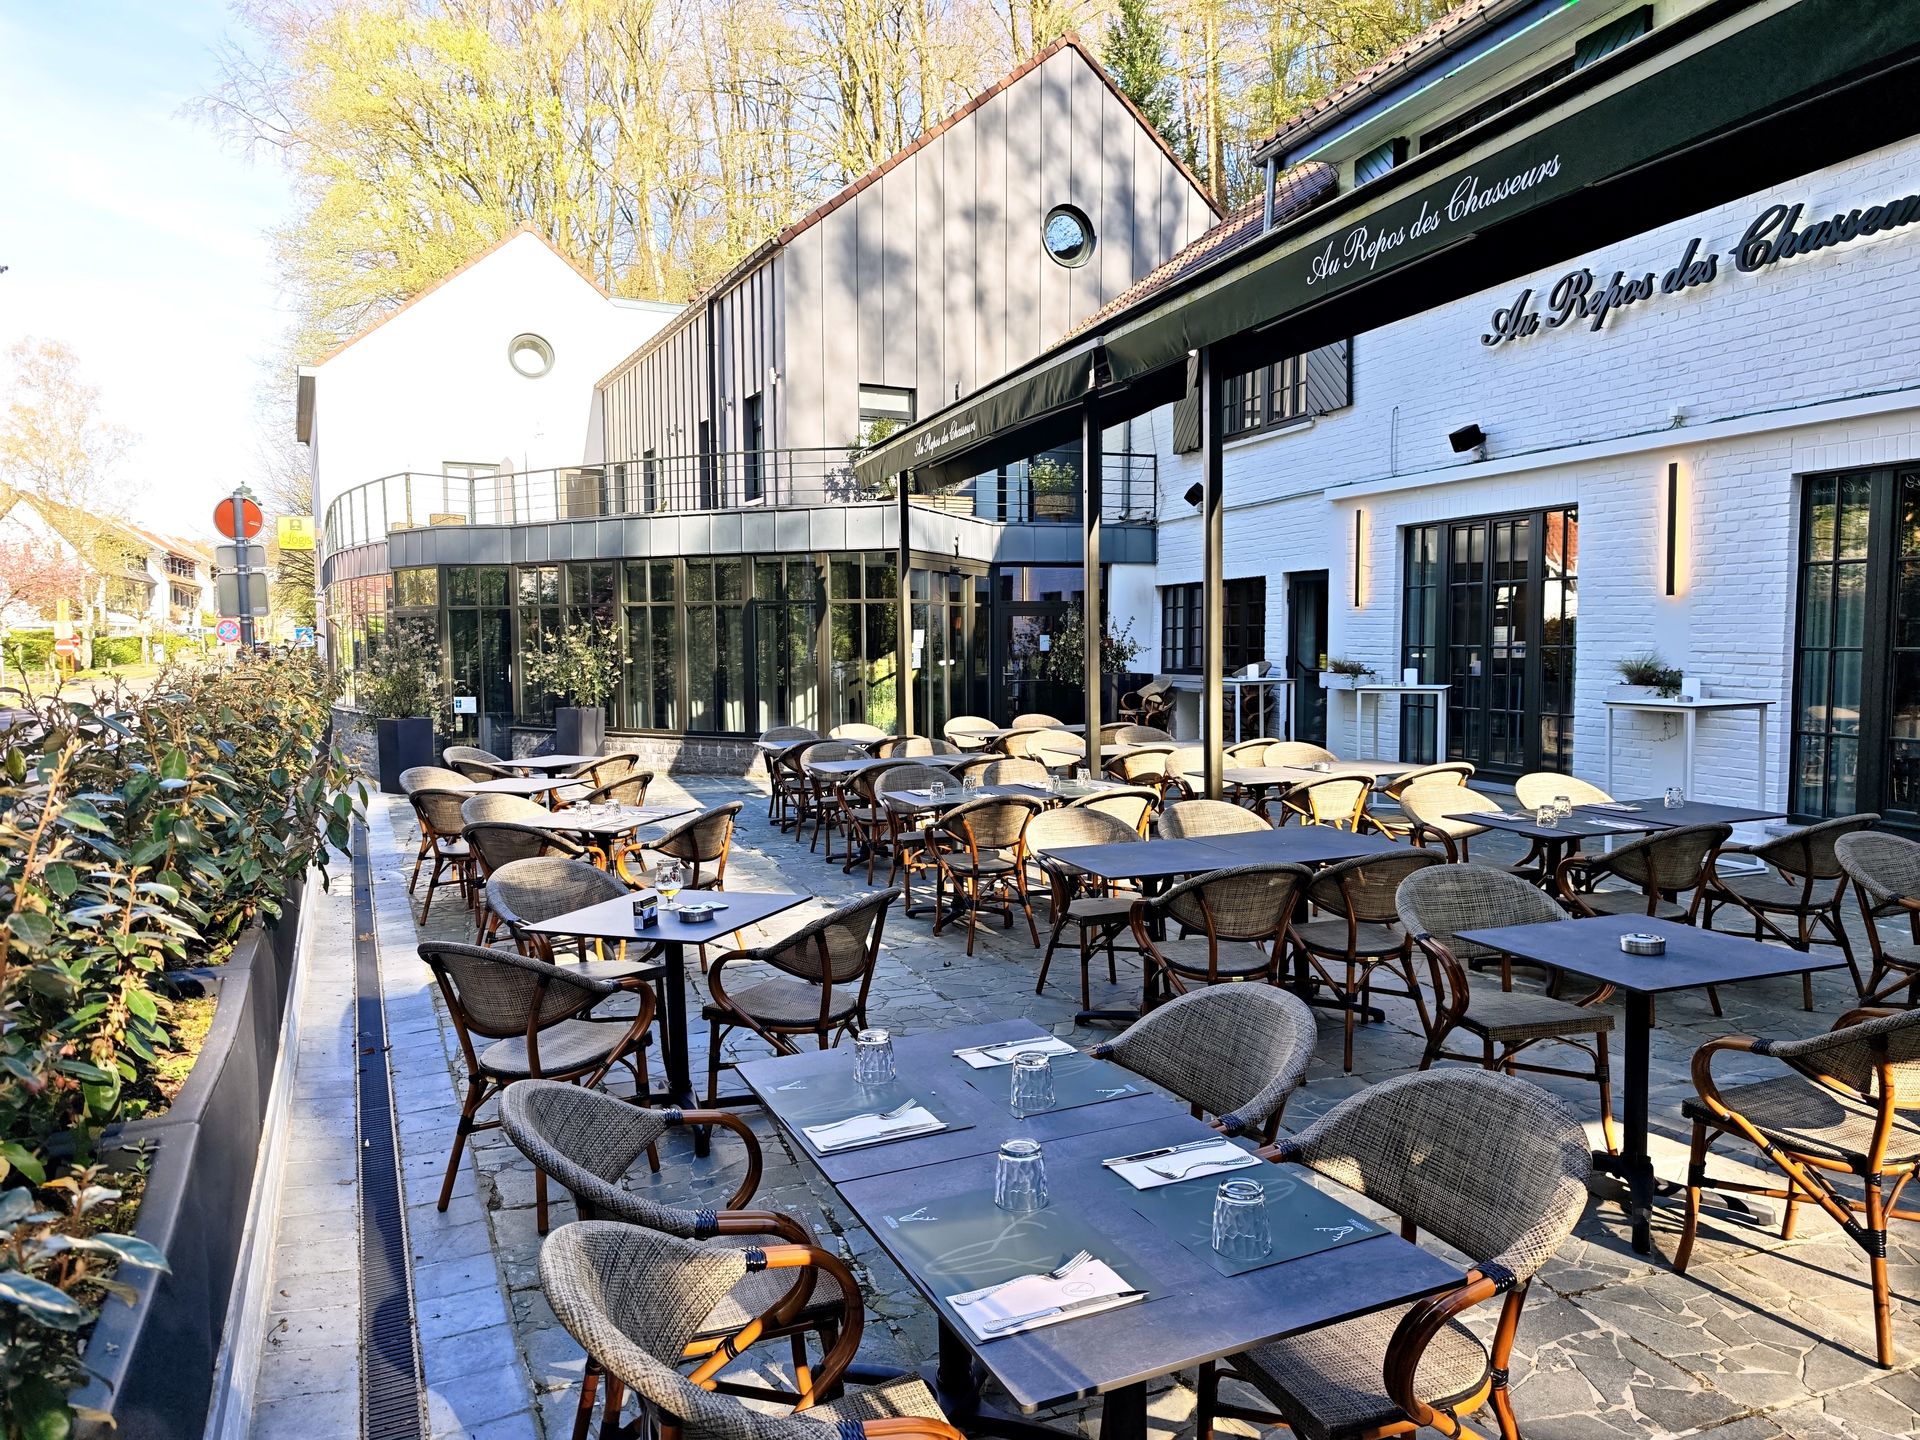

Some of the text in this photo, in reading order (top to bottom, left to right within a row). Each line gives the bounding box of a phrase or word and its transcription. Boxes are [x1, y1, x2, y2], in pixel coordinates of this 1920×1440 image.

[1306, 154, 1561, 285] Au Repos des Chasseurs
[1481, 194, 1920, 346] Au Repos des Chasseu
